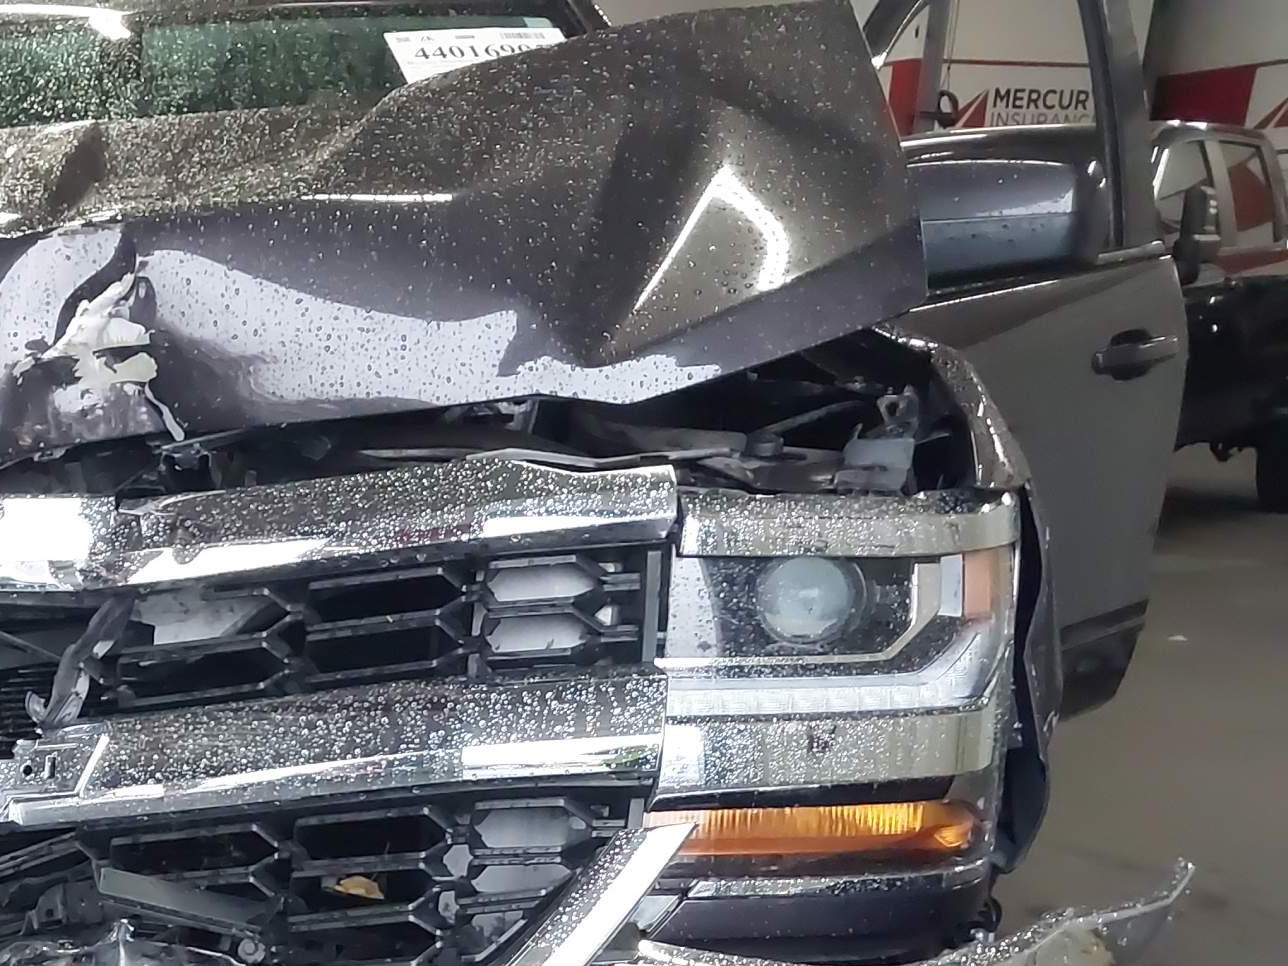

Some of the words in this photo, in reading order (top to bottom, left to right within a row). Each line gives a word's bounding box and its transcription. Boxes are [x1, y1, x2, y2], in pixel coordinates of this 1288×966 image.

[414, 43, 553, 60] 4401690
[991, 87, 1090, 111] MERCUR
[989, 111, 1096, 128] INSURANC
